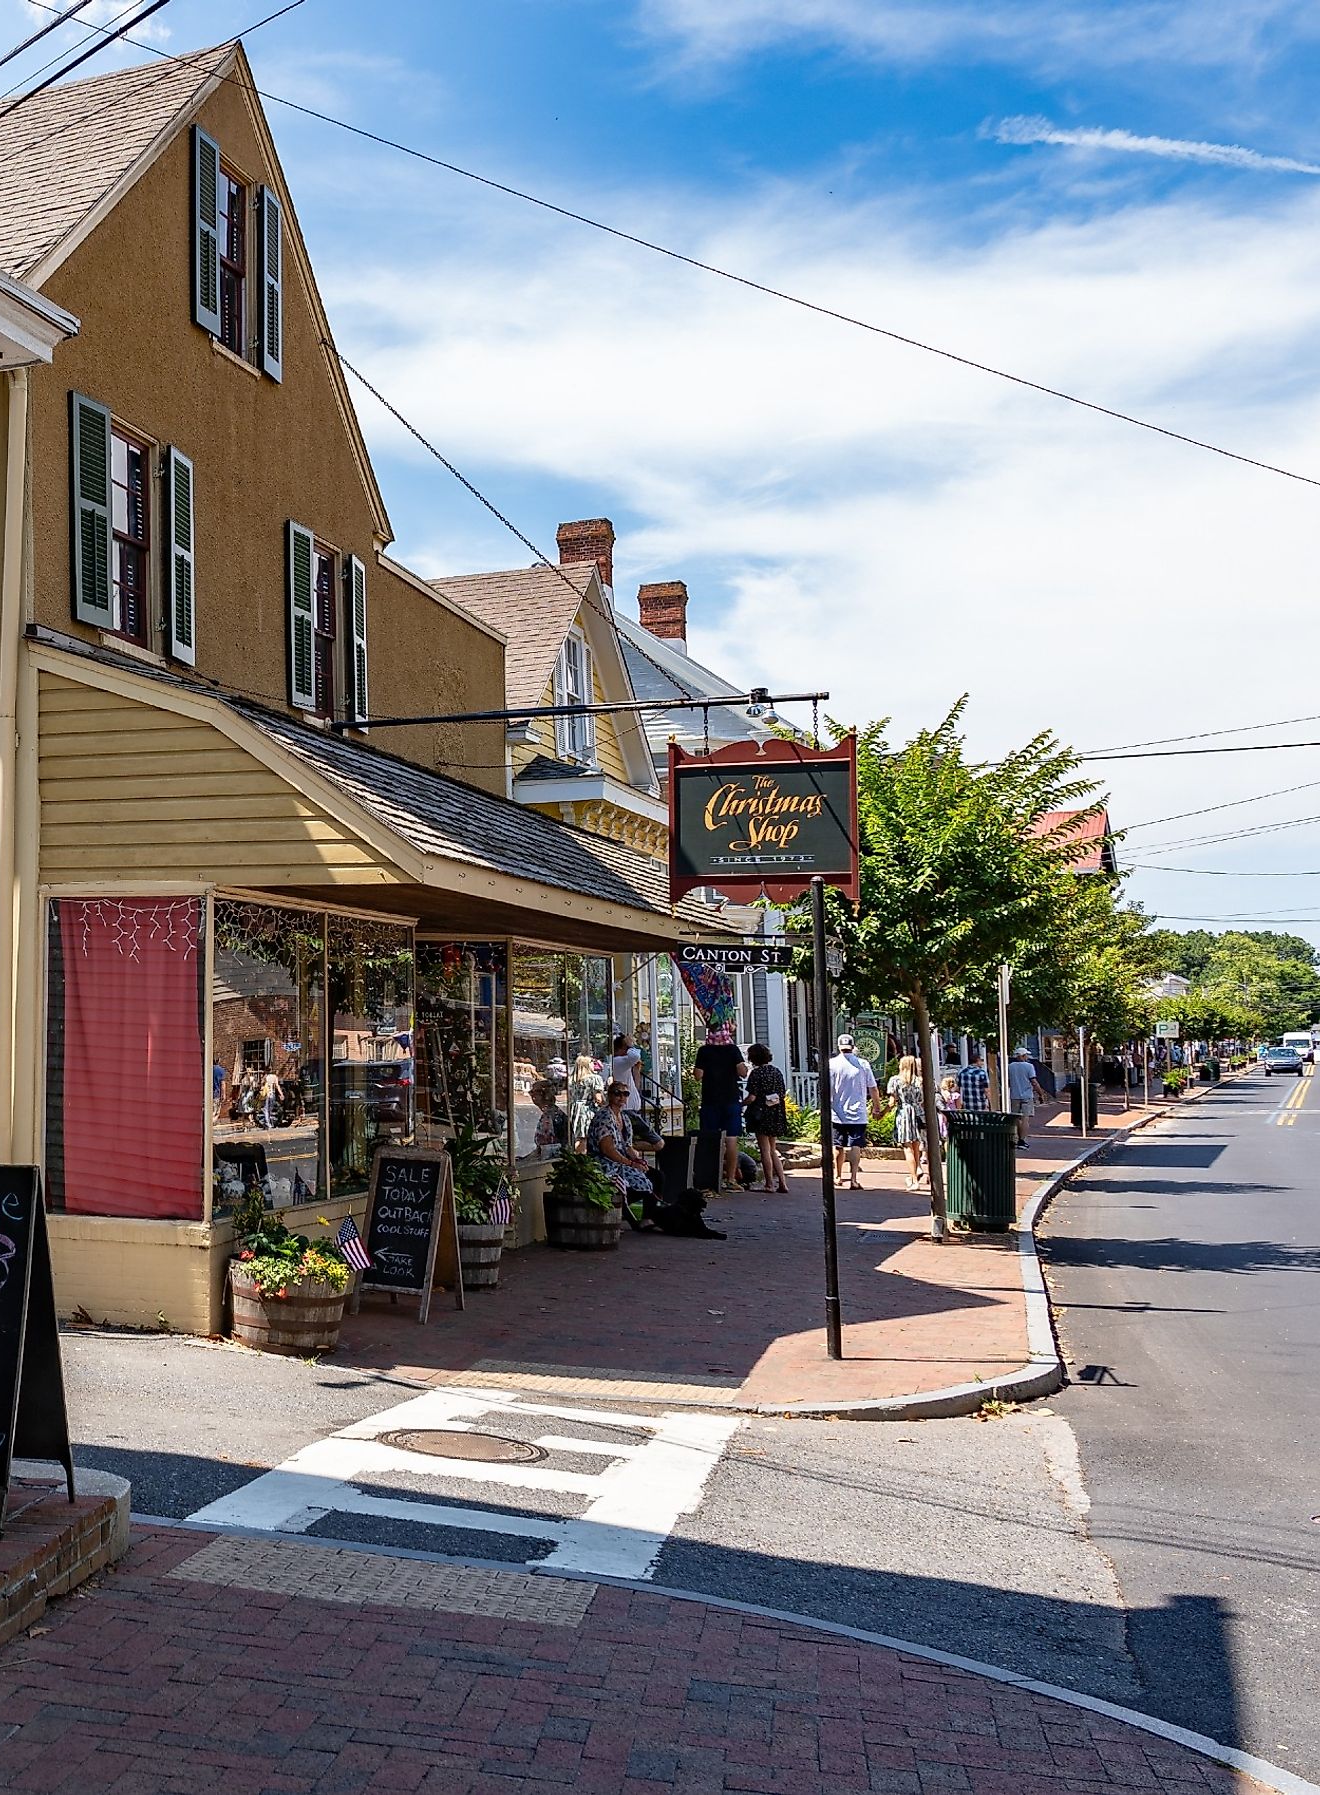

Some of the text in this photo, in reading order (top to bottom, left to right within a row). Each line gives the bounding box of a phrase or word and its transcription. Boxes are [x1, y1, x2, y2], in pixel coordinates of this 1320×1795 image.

[752, 775, 775, 790] The
[704, 784, 827, 832] Christmas
[729, 815, 800, 852] Shop
[682, 946, 785, 964] CANTON ST.
[1159, 1024, 1169, 1034] P
[385, 1164, 431, 1184] SALE
[381, 1185, 431, 1203] TODAY
[376, 1223, 403, 1236] COOL
[382, 1266, 415, 1278] LOOK
